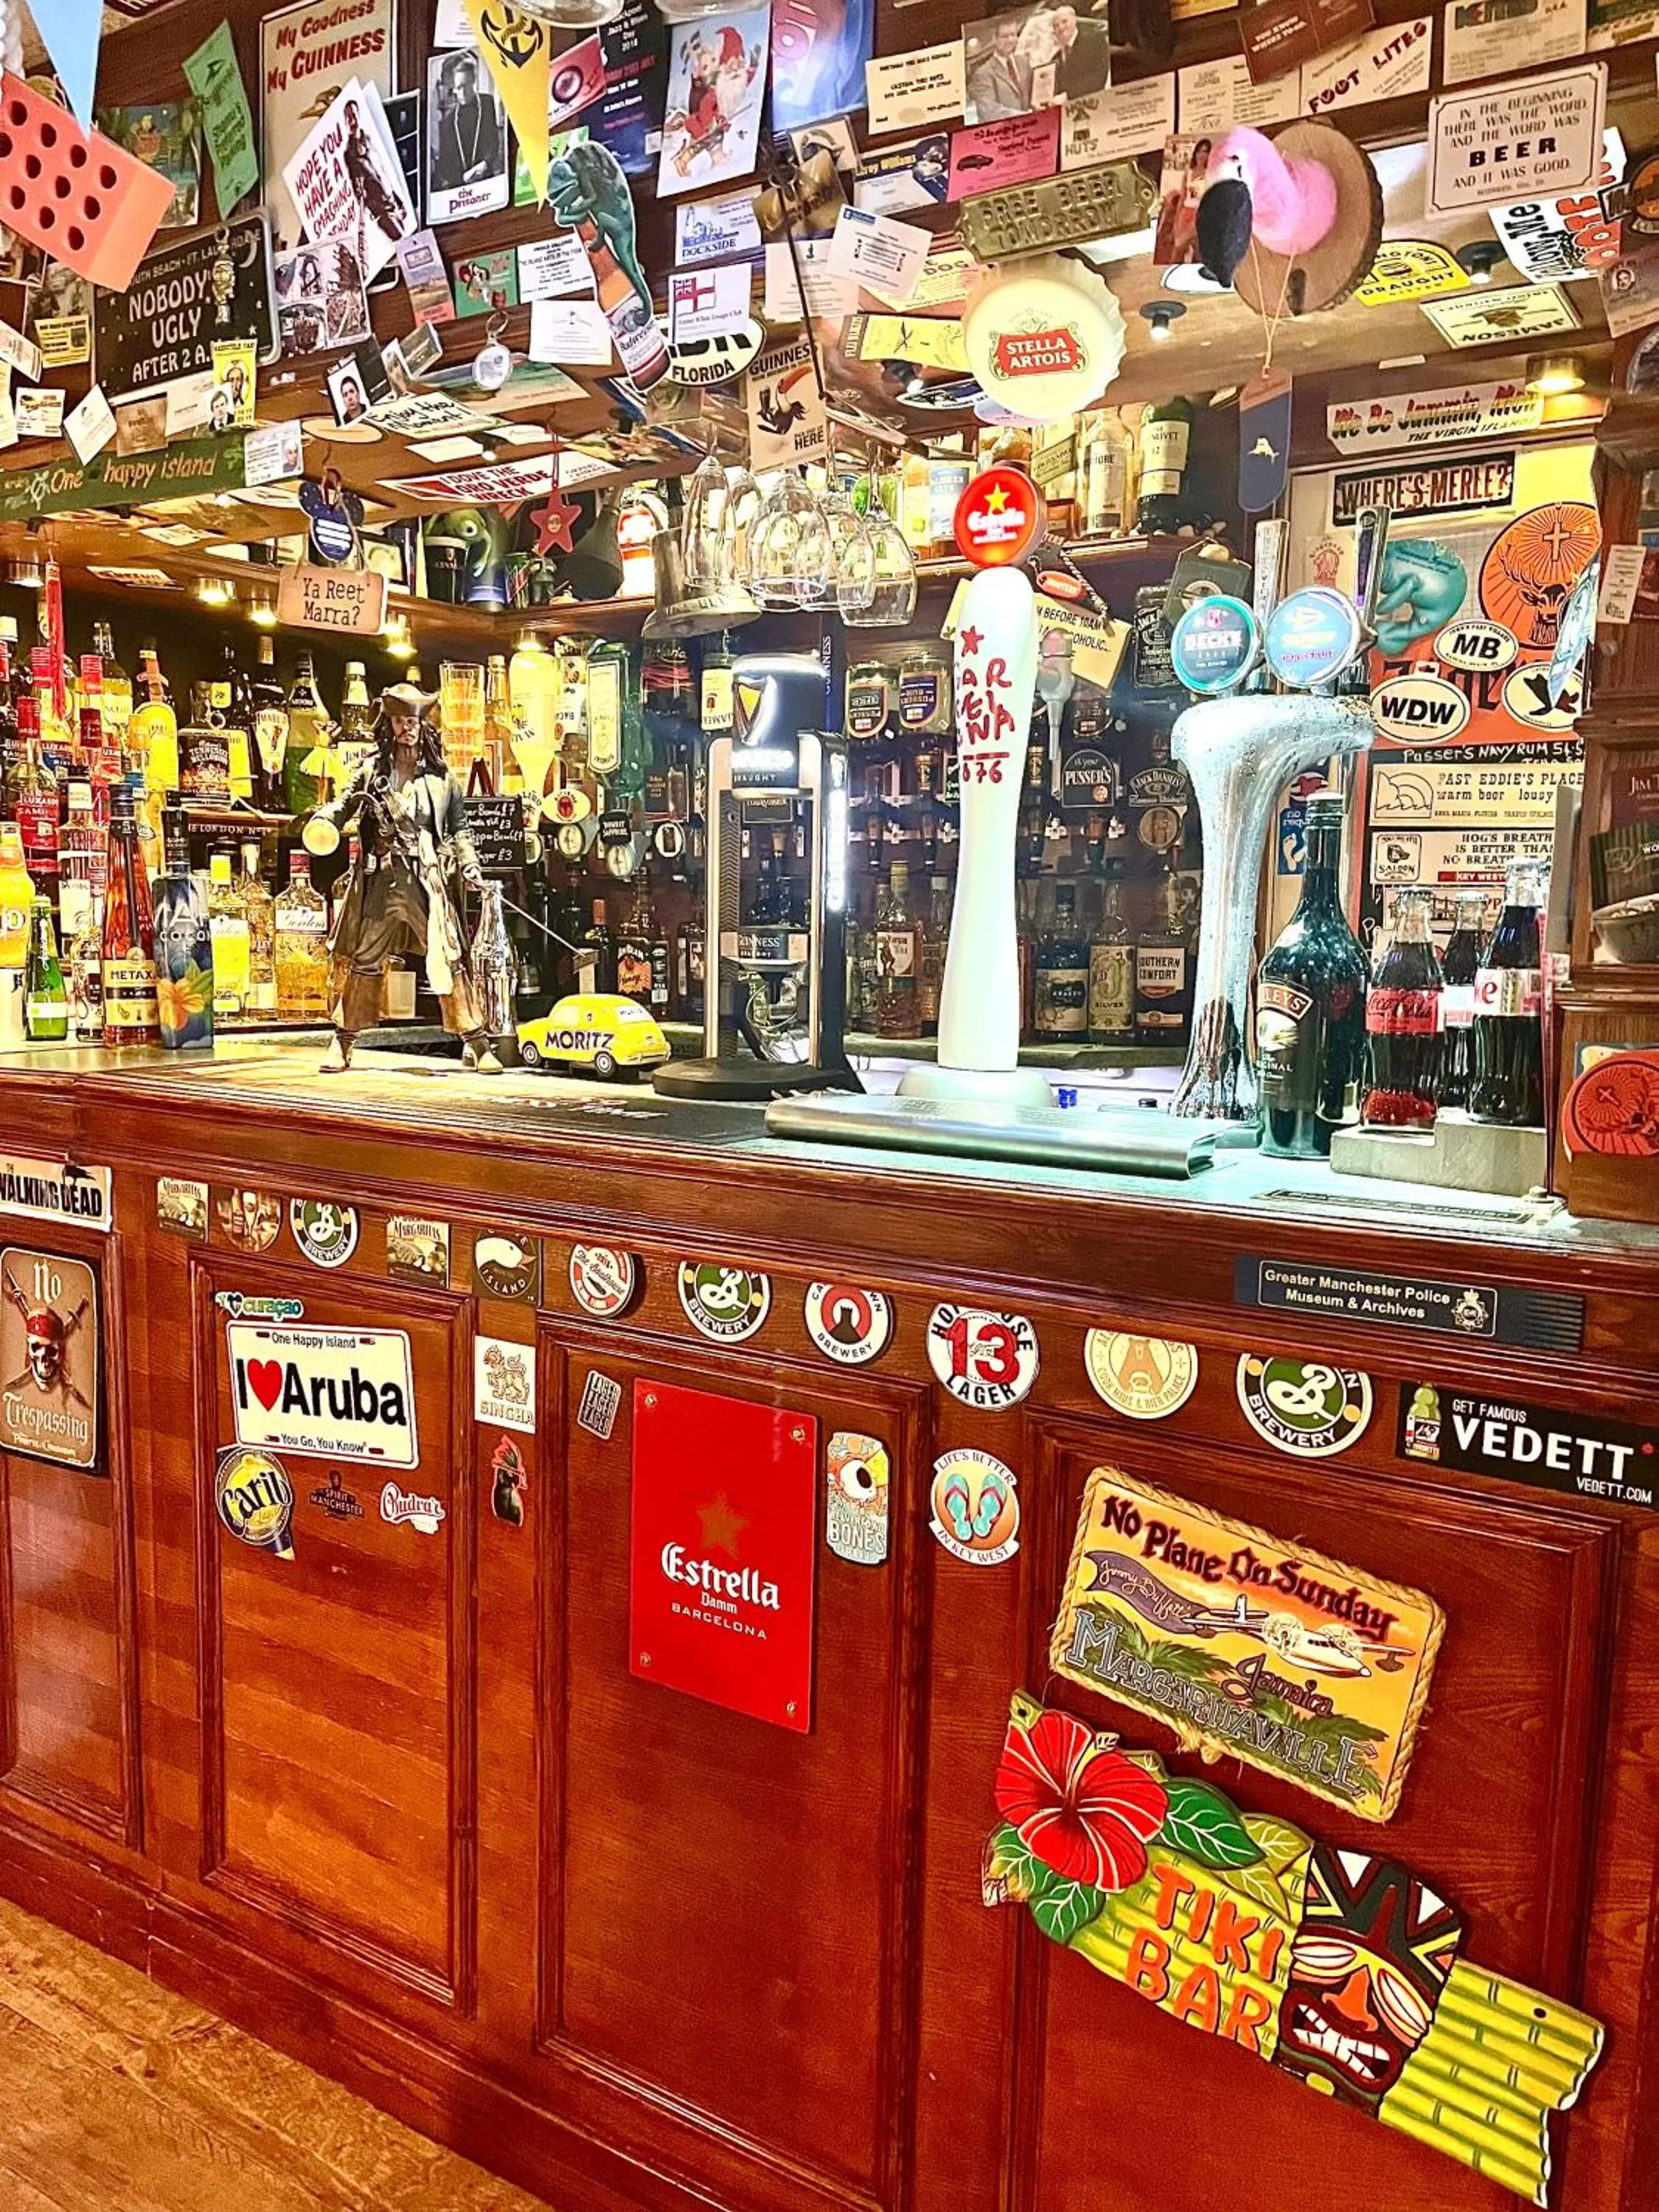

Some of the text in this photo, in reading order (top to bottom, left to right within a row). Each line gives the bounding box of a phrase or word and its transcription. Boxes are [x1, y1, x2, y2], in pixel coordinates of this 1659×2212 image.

[276, 2, 375, 49] My Goodness
[267, 27, 386, 94] My GUINNESS
[1460, 87, 1573, 119] IN THE BEGINNING
[1444, 122, 1476, 136] THERE
[1486, 114, 1511, 128] WAS
[1520, 108, 1539, 120] THE
[1450, 116, 1580, 148] AND THE WORD WAS
[296, 123, 343, 197] HOPE YOU
[1469, 137, 1557, 167] BEER
[304, 158, 343, 219] HAVE A
[1453, 175, 1476, 189] AND
[1500, 165, 1526, 181] WAS
[449, 192, 491, 215] Prisoner
[978, 171, 1123, 230] FREE BEER
[681, 237, 737, 257] DOCKSIDE
[153, 258, 181, 279] BEACH
[1362, 271, 1455, 296] DRAUGHT
[151, 307, 201, 348] UGLY
[1461, 318, 1565, 342] JAMESON
[749, 342, 813, 376] GUINNES
[1006, 337, 1067, 355] STELLA
[132, 349, 191, 383] AFTER 2
[672, 358, 735, 383] FLORIDA
[1009, 352, 1071, 369] ARTOIS
[1367, 404, 1394, 434] Be
[794, 430, 824, 451] HERE
[1407, 434, 1431, 442] THE
[1435, 425, 1477, 438] VIRGIN
[50, 453, 216, 493] One happy island
[448, 466, 519, 484] DOVE THE
[455, 480, 497, 495] ORO
[500, 470, 552, 487] VERDE
[470, 487, 534, 501] WRECK
[1342, 464, 1508, 514] WHERE'S MERLE?
[303, 577, 365, 603] Ya Reet
[304, 602, 360, 625] Marra?
[1043, 608, 1077, 625] BEFORE
[1452, 633, 1501, 659] MB
[1380, 695, 1457, 725] WDW
[1517, 742, 1548, 755] RUM
[1065, 767, 1111, 785] PUSSER'S
[1438, 773, 1584, 785] FAST EDDIE'S PLACE
[1437, 791, 1472, 800] warm
[1518, 789, 1554, 804] lousy
[201, 824, 244, 834] LONDON
[1462, 834, 1552, 843] HOG'S BREATH
[1455, 845, 1515, 854] IS BETTER
[1138, 956, 1180, 969] SOUTHERN
[1139, 968, 1176, 981] COMFORT
[546, 1030, 615, 1051] MORITZ
[60, 1183, 102, 1217] DEAD
[305, 1238, 349, 1261] BREWERY
[34, 1260, 61, 1304] No
[481, 1270, 526, 1294] ISLAND
[1265, 1268, 1450, 1304] Greater Manchester Police
[689, 1300, 751, 1335] BREWERY
[1286, 1288, 1425, 1319] Museum & Archives
[271, 1332, 356, 1350] One Happy Island
[818, 1331, 874, 1358] BREWERY
[946, 1318, 1020, 1384] 13
[236, 1358, 408, 1427] I Aruba
[946, 1374, 1017, 1405] LAGER
[3, 1391, 88, 1445] Trespassing
[480, 1401, 535, 1426] SINGHA
[1248, 1394, 1336, 1447] BREWERY
[1453, 1398, 1527, 1424] GET FAMOUS
[280, 1433, 299, 1446] You
[316, 1437, 334, 1450] You
[1451, 1415, 1635, 1480] VEDETT
[937, 1450, 1014, 1485] LIFE'S BETTER
[222, 1471, 292, 1536] Carib
[325, 1488, 348, 1502] SPIRIT
[1576, 1475, 1652, 1504] VEDETT.COM
[311, 1495, 364, 1514] MANCHESTER
[830, 1520, 886, 1555] BONES
[937, 1528, 1010, 1563] IN KEY WEST
[661, 1542, 780, 1610] Estrella
[1099, 1560, 1142, 1593] Jimmy
[1102, 1496, 1400, 1643] No Plane On Sunday
[701, 1592, 737, 1614] Damm
[672, 1602, 768, 1640] BARCELONA
[1221, 1653, 1334, 1717] Jamaica
[1065, 1609, 1379, 1797] MARGARITAVILLE
[1152, 1862, 1285, 1983] TIKI
[1123, 1930, 1273, 2055] BAR
